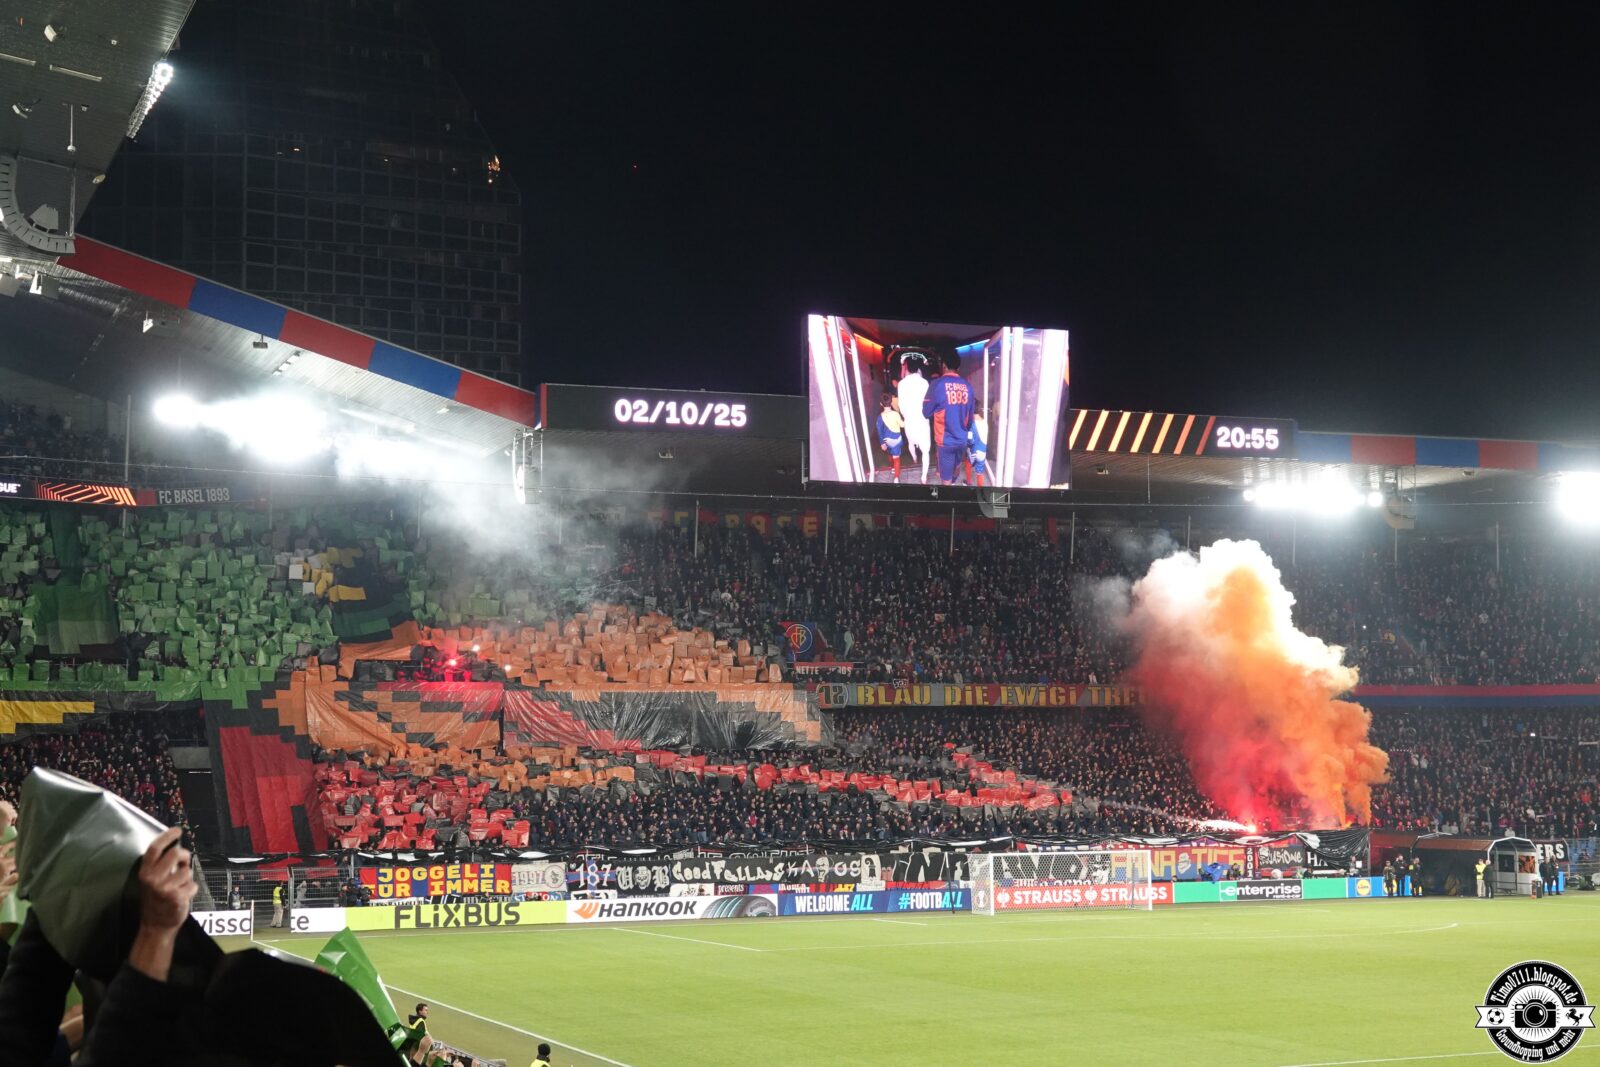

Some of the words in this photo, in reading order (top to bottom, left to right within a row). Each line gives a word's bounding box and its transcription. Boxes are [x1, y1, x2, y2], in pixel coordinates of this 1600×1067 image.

[946, 390, 969, 405] 1893
[614, 398, 747, 427] 02/10/25
[1216, 426, 1280, 450] 20:55
[158, 490, 173, 504] FC
[174, 489, 203, 504] BASEL
[206, 488, 230, 502] 1893
[856, 684, 932, 705] BLAU
[1246, 847, 1254, 878] 2001
[377, 863, 495, 883] JOGGELI
[512, 870, 546, 886] 1997
[575, 863, 612, 888] 187
[430, 879, 512, 897] IMMER
[1013, 890, 1082, 905] STRAUSS
[1100, 886, 1168, 903] STRAUSS
[1222, 882, 1302, 898] enterprise
[795, 893, 850, 913] WELCOME
[850, 891, 874, 911] ALL
